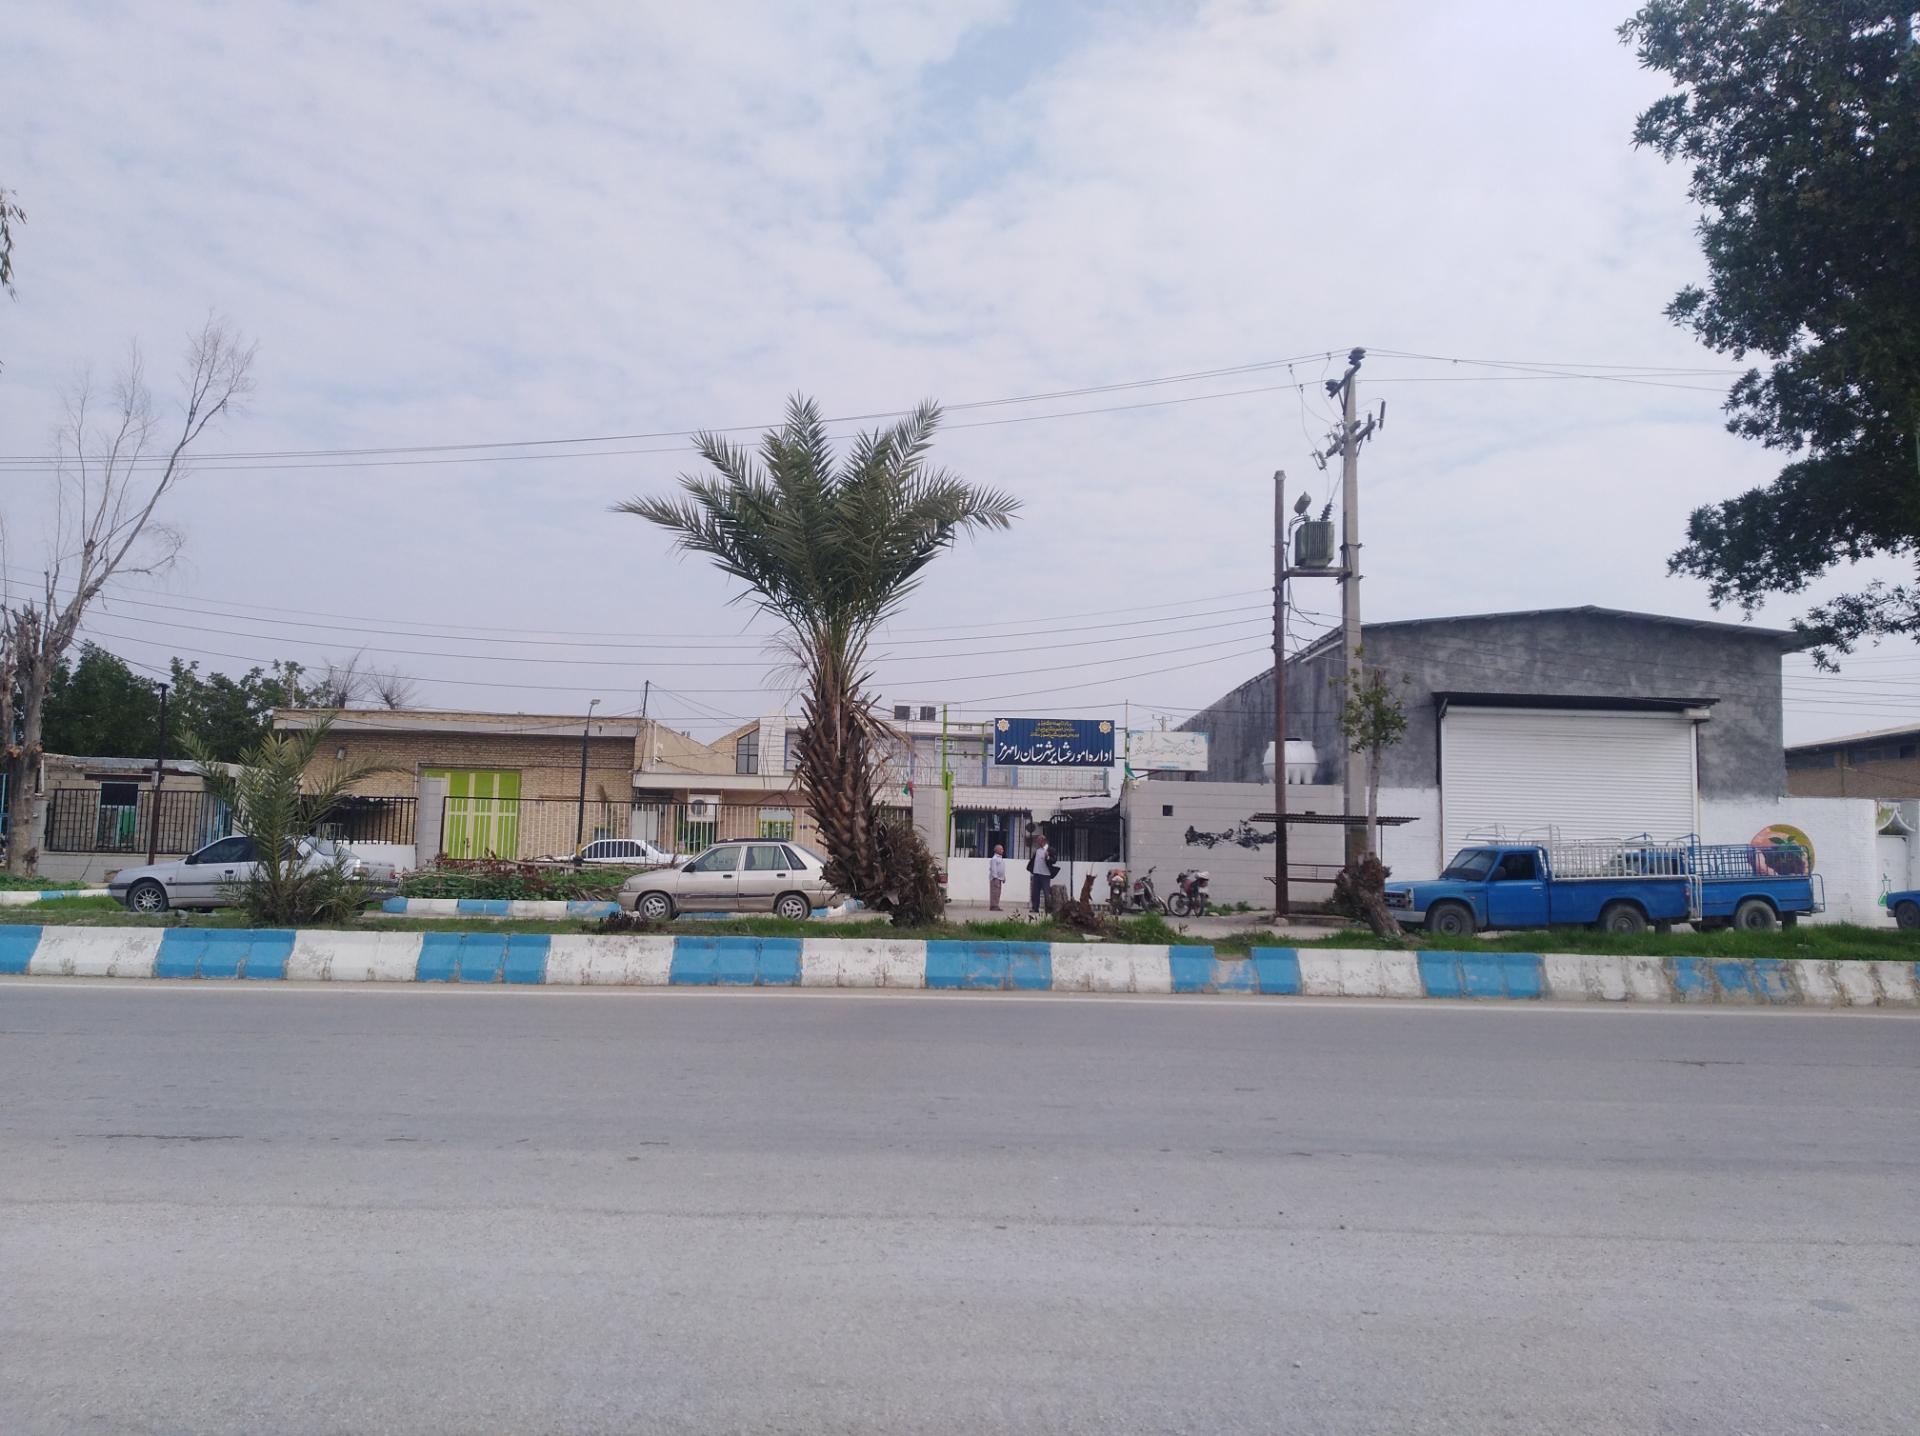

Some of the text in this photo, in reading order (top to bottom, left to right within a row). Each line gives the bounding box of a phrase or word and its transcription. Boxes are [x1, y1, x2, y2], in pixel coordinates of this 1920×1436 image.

[997, 741, 1112, 764] اداره امور عشایر شهرستان رامهرمز
